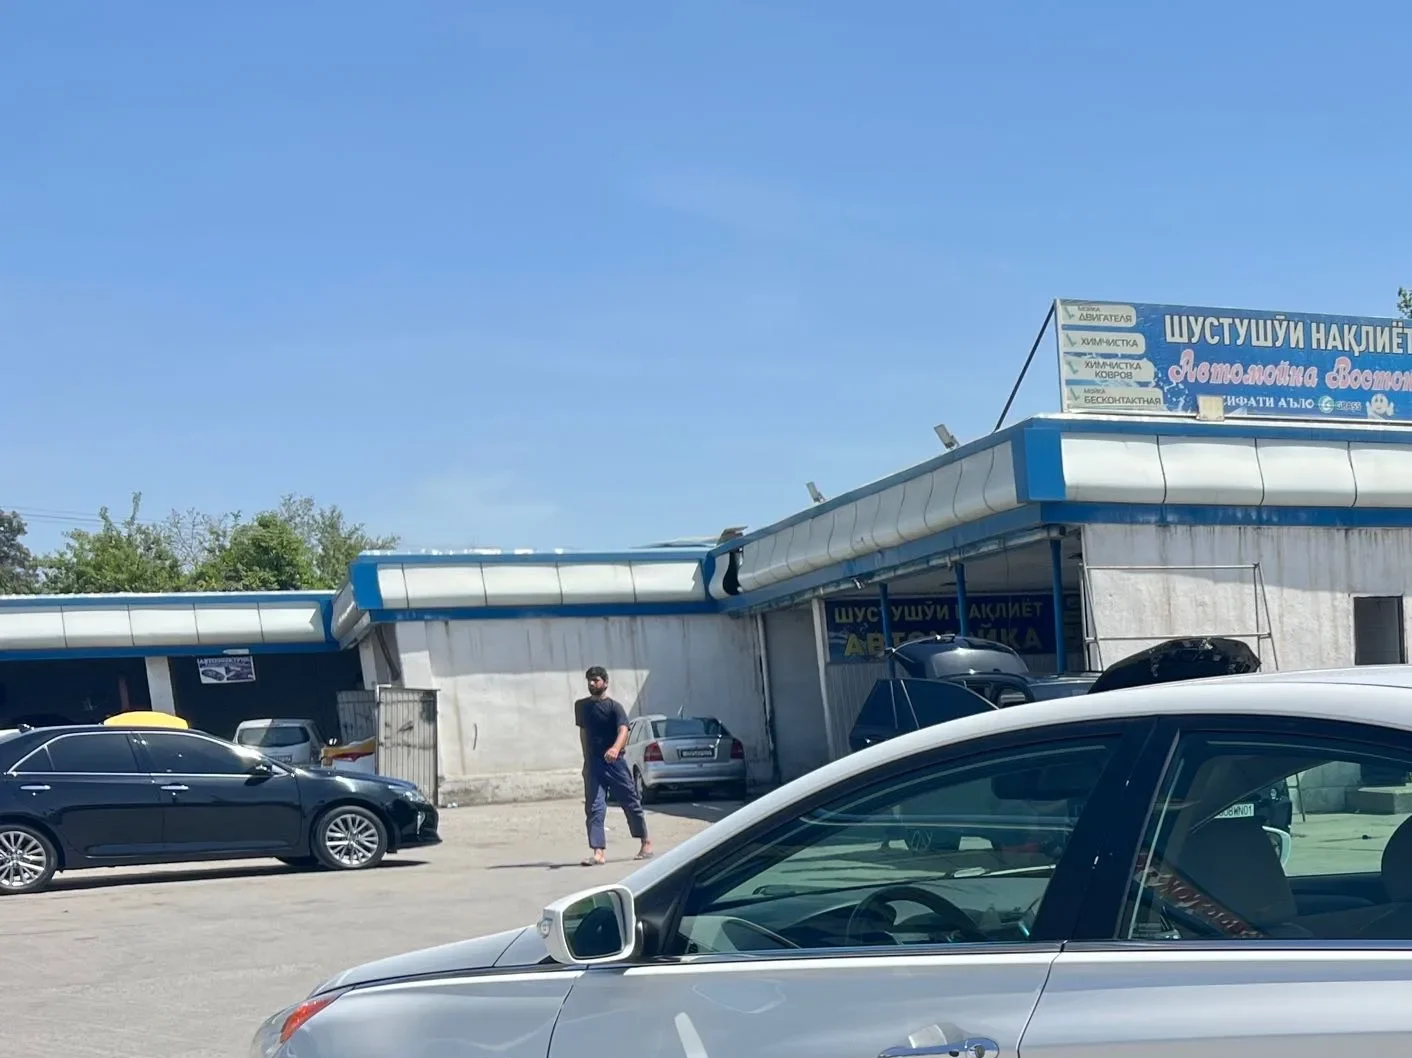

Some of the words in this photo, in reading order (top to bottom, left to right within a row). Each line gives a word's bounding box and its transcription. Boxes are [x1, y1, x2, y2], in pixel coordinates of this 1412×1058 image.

[1079, 312, 1133, 323] ДВИГАТЕЛЯ
[1081, 337, 1139, 348] ХИМЧИСТКА
[1084, 360, 1142, 370] ХИМЧИСТКА
[1094, 370, 1133, 380] КОВРОВ
[1084, 395, 1161, 405] БЕСКОНТАКТНАЯ
[834, 600, 950, 624] ШУСУШӮИ
